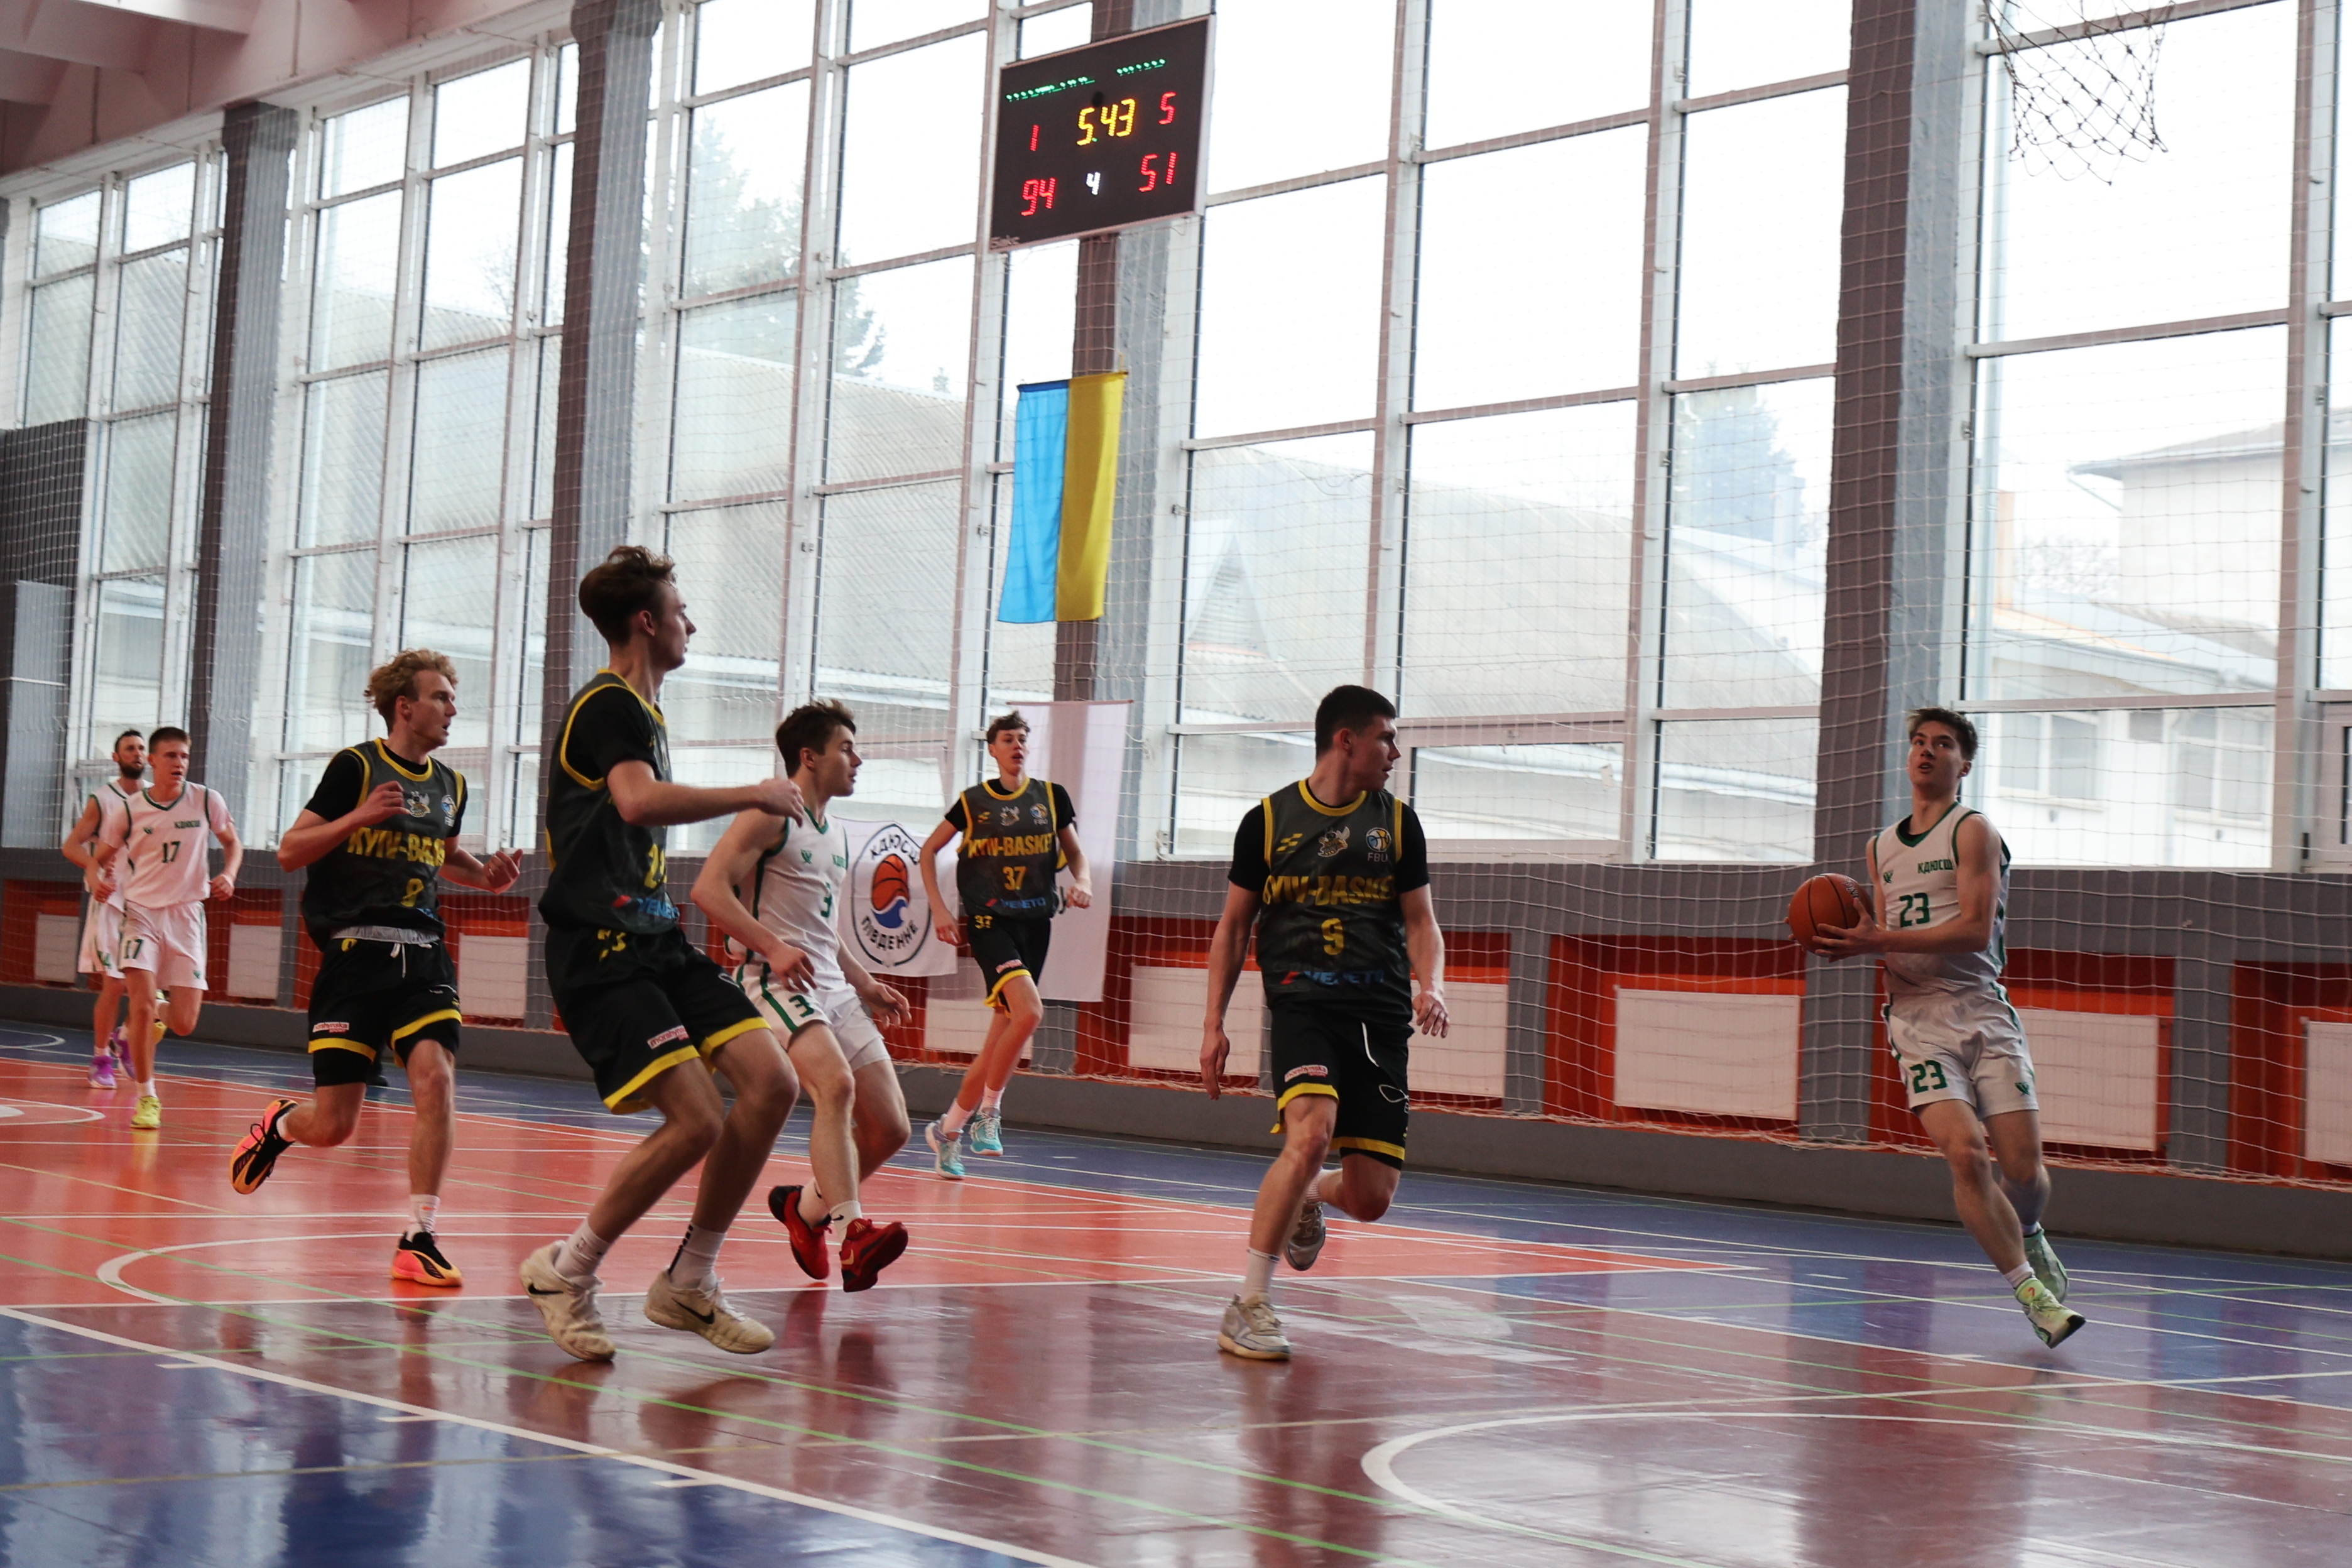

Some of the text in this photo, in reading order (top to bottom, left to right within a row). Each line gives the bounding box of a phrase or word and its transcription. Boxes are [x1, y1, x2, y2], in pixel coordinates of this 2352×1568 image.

[1158, 92, 1176, 124] 5
[1030, 124, 1039, 151] 1
[1086, 172, 1101, 195] 4
[1139, 152, 1177, 192] 51
[1021, 178, 1056, 216] 94
[161, 841, 181, 863] 17
[1367, 852, 1388, 863] FBU
[1002, 866, 1027, 891] 37
[1917, 859, 1953, 874] КДЮСШ
[1899, 892, 1930, 928] 23
[124, 939, 144, 960] 17
[1320, 917, 1344, 956] 9
[788, 994, 815, 1018] 3
[1909, 1060, 1947, 1094] 23
